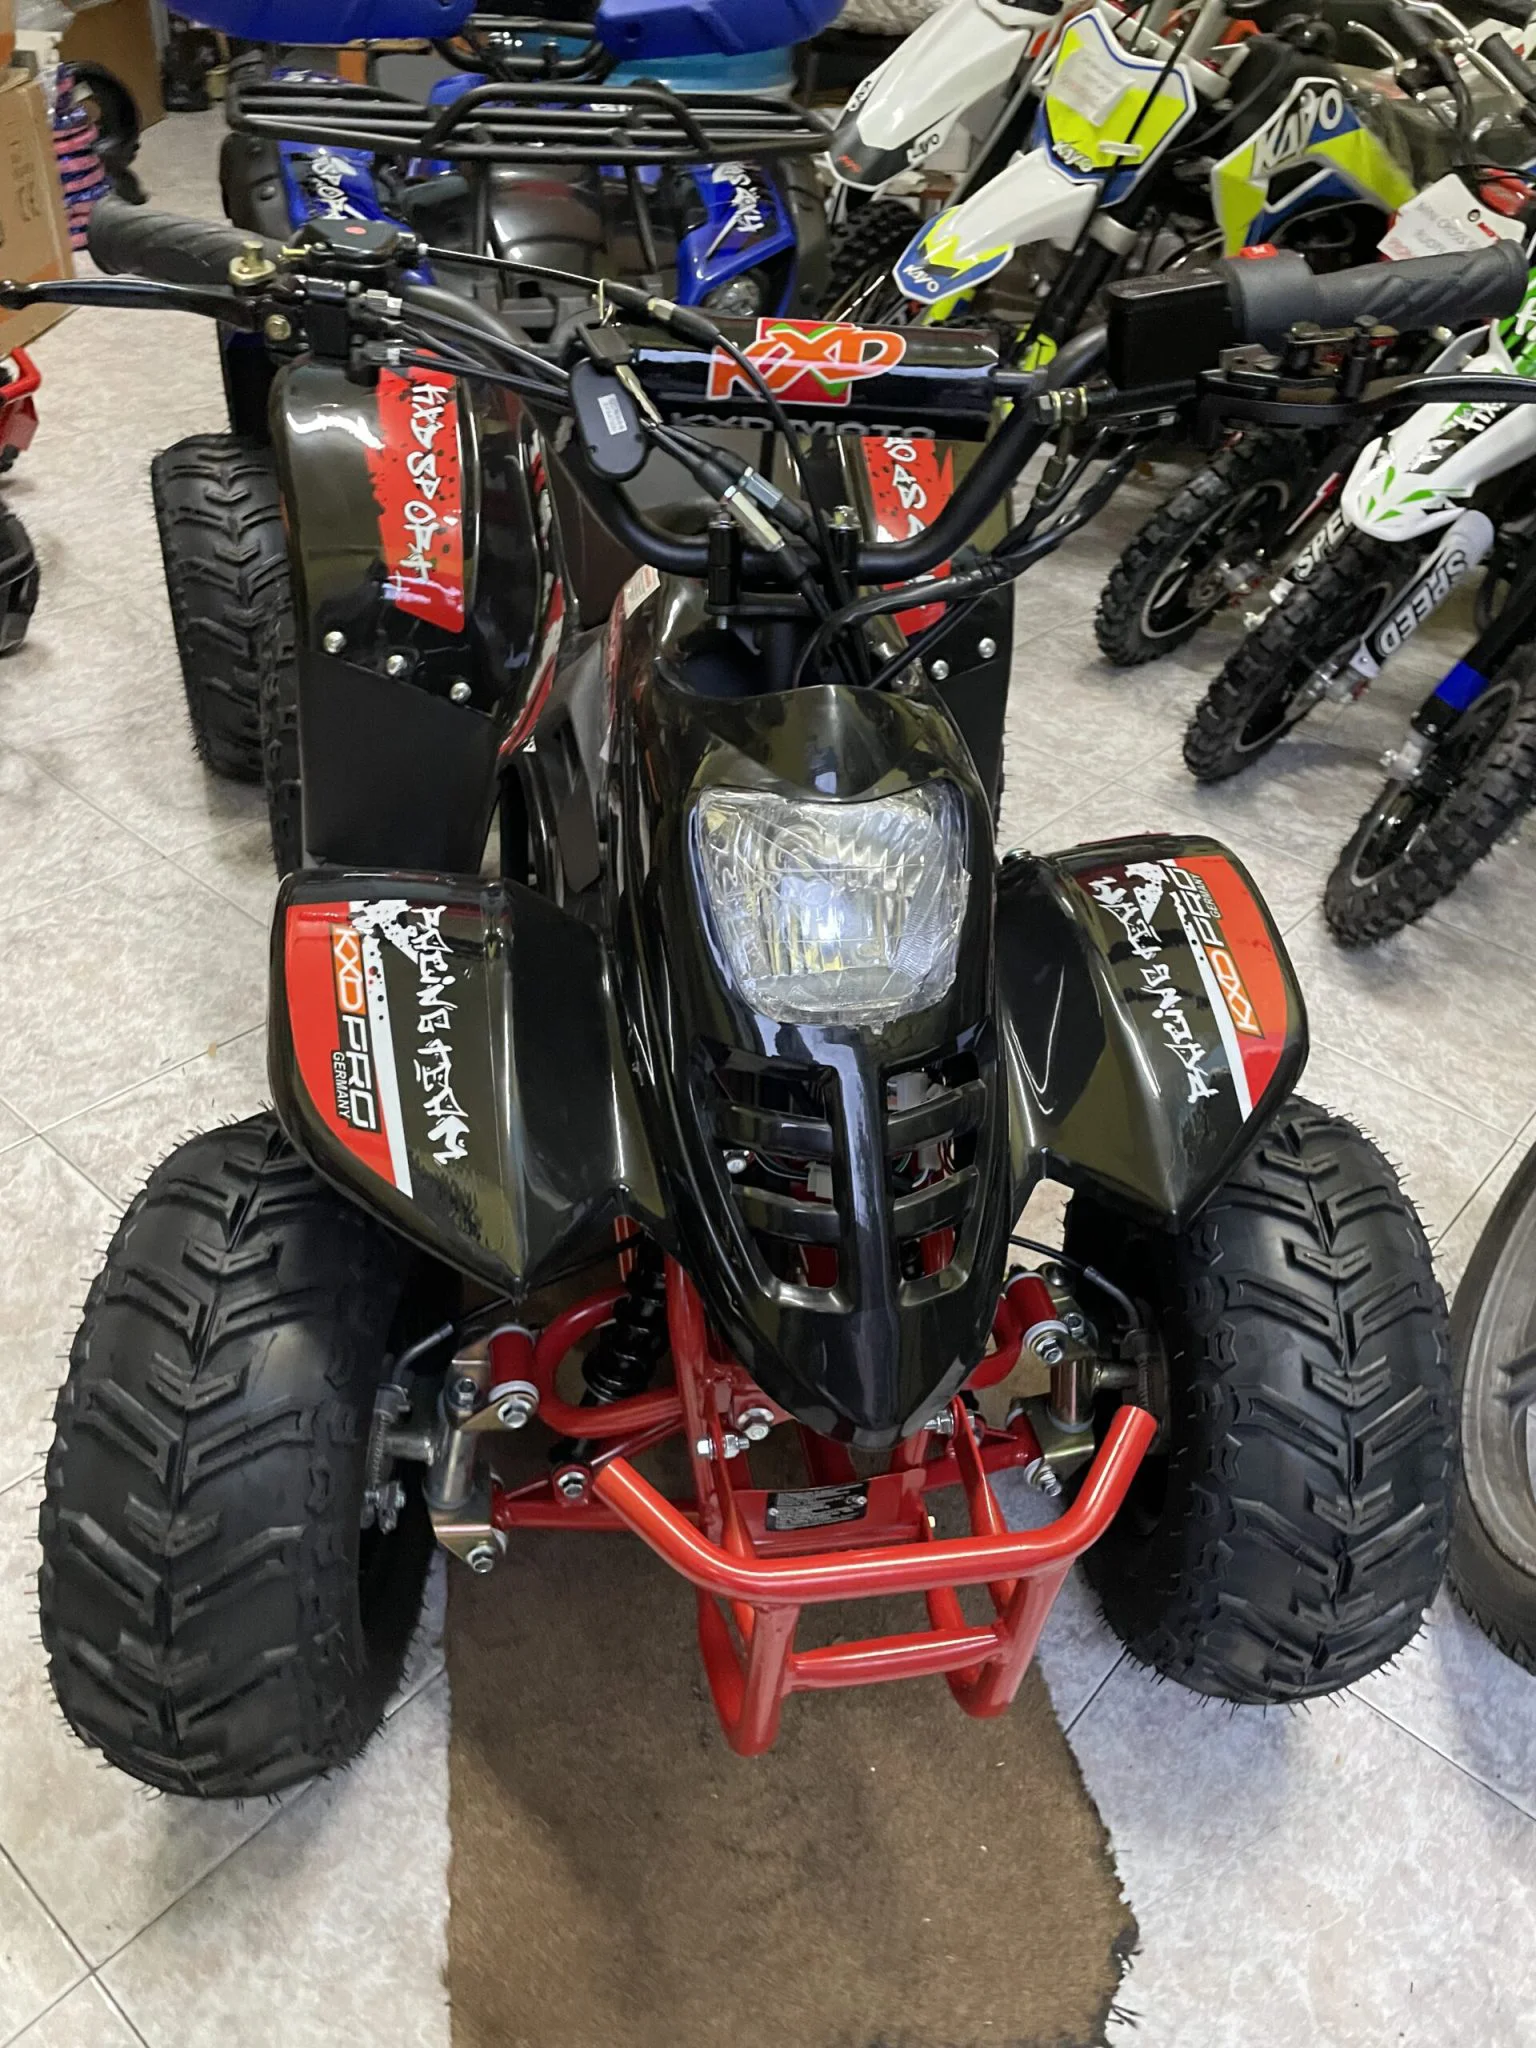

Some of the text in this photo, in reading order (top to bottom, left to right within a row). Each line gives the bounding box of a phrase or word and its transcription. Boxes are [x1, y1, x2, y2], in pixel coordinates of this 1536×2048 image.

[706, 327, 906, 400] KXD
[1196, 874, 1222, 919] GERMANY
[1170, 866, 1260, 1033] KXD PRO
[332, 927, 378, 1131] KXD PRO
[332, 1050, 352, 1119] GERMANY
